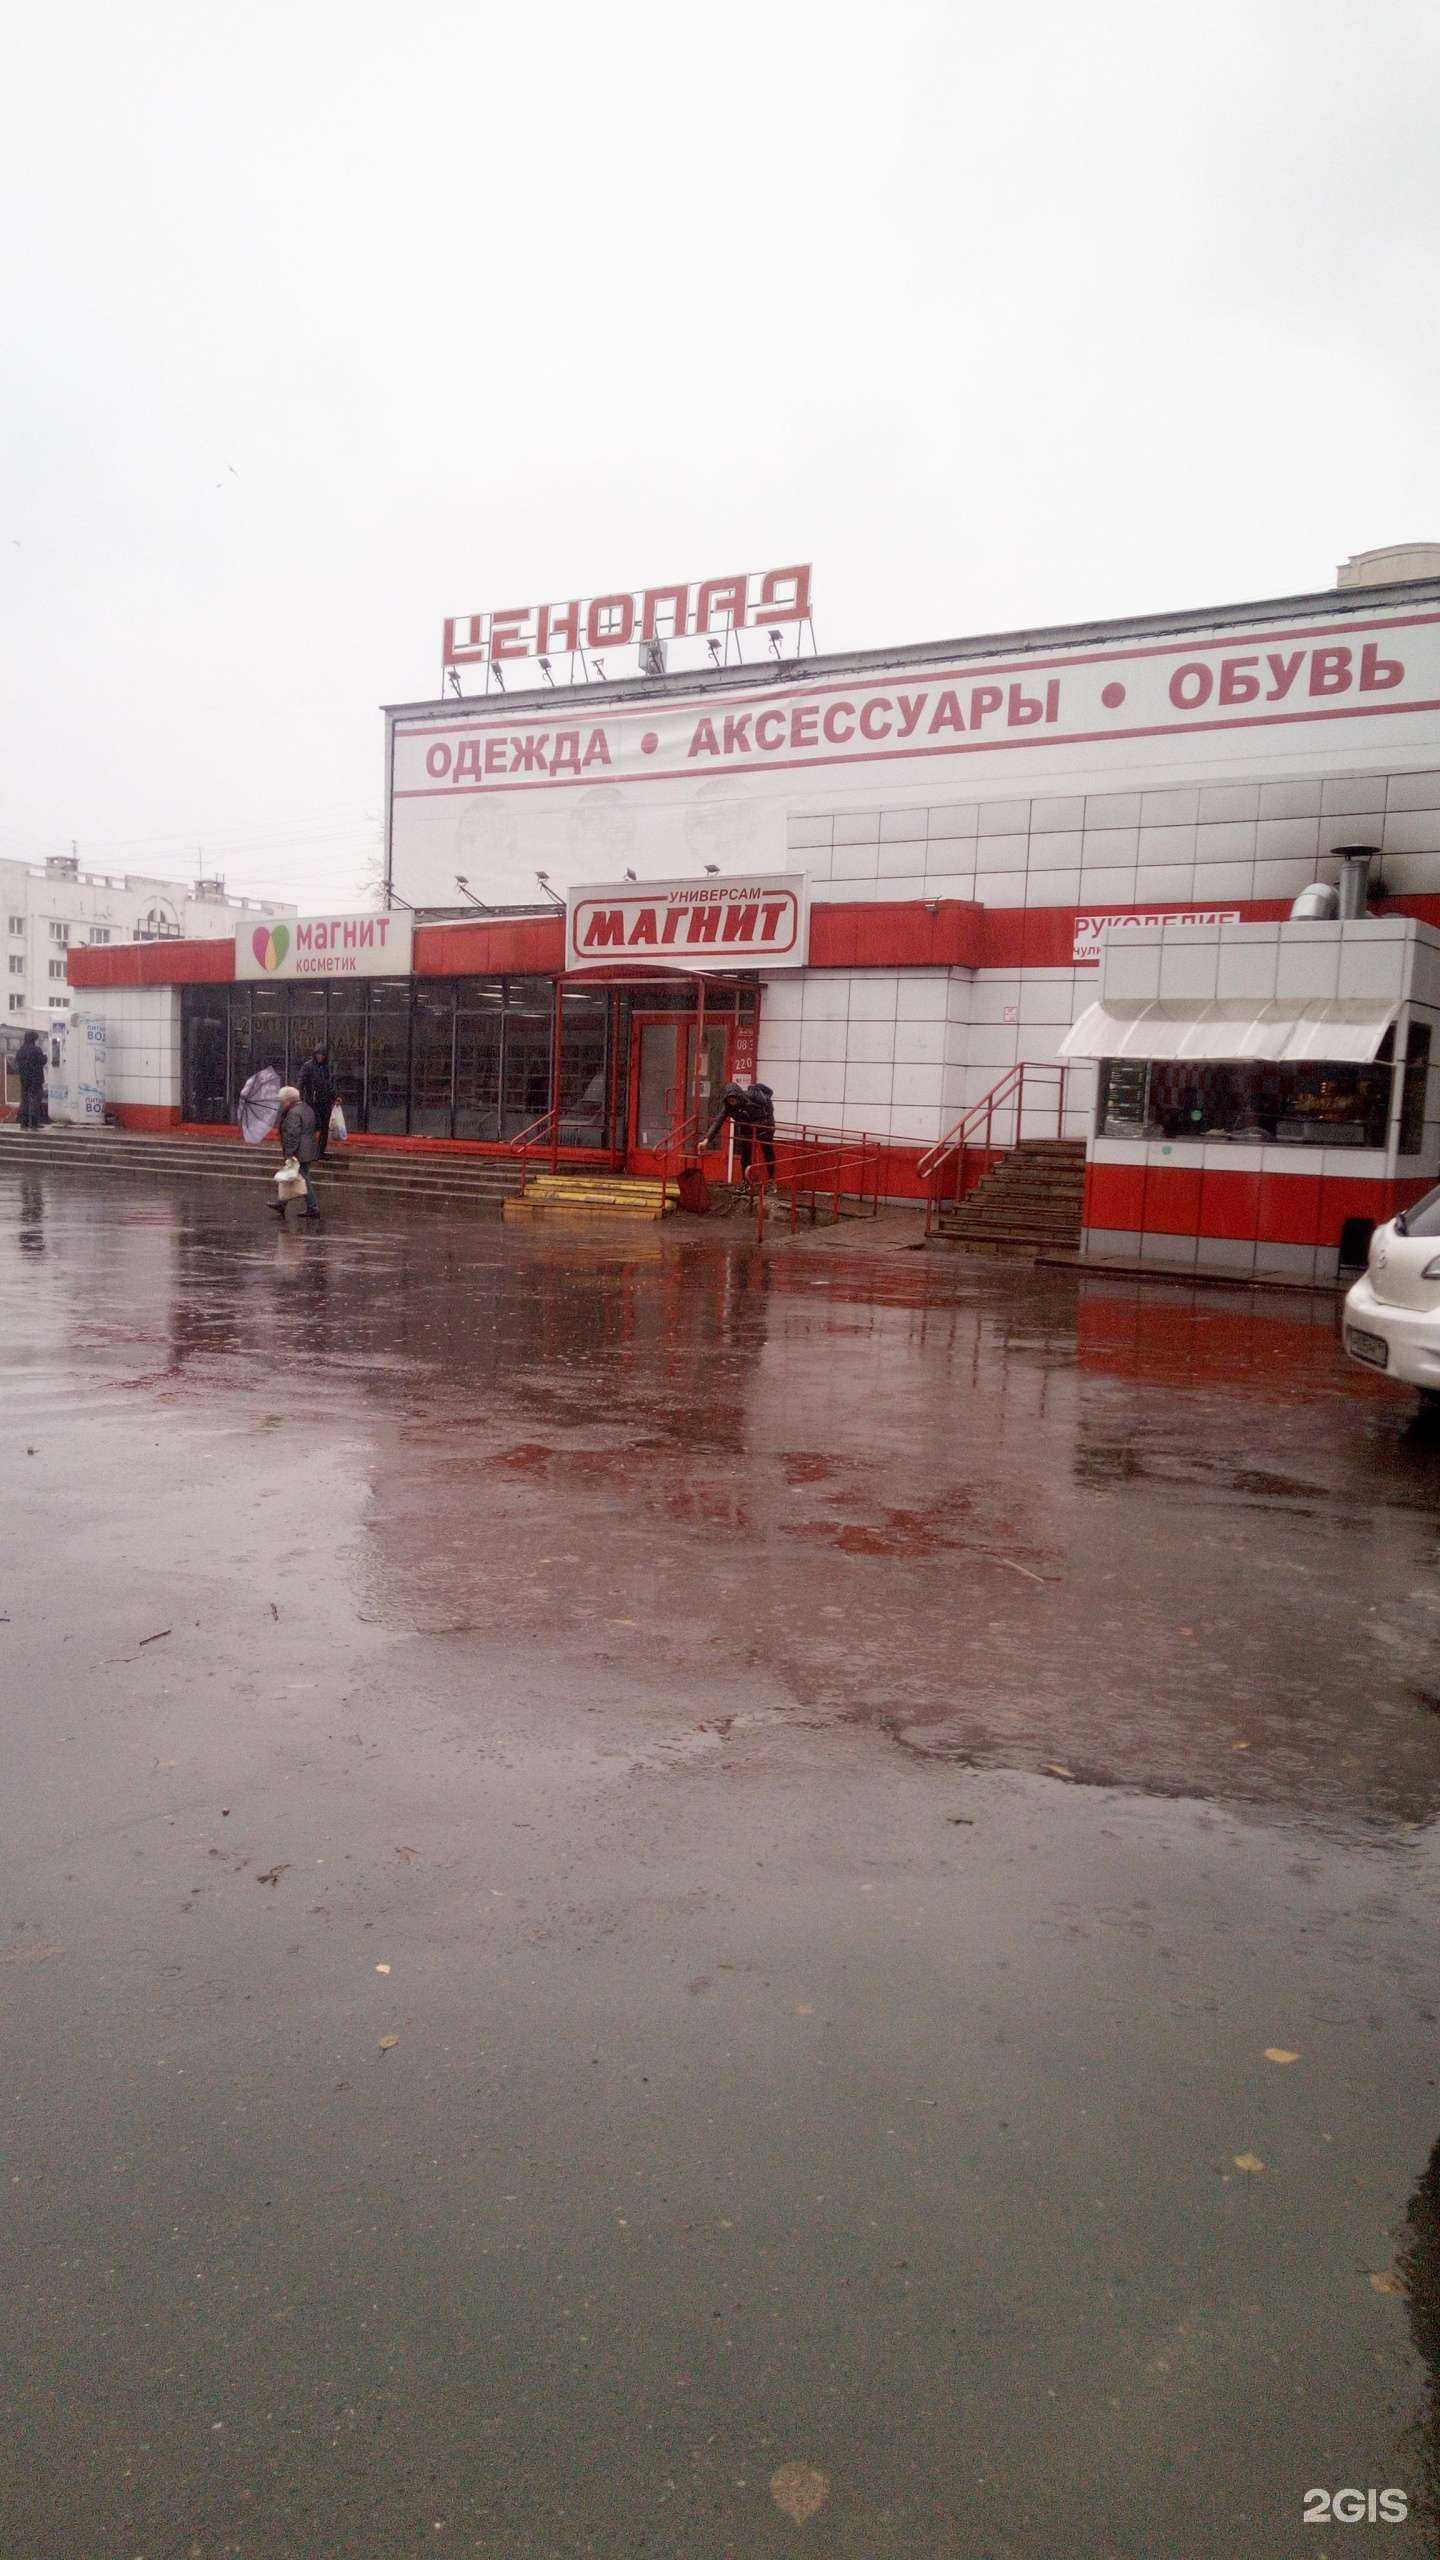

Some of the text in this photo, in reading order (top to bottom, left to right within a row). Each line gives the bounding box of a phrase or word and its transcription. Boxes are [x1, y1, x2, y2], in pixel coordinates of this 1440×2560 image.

[443, 563, 812, 666] ЦЕНОПАД
[426, 642, 1406, 783] ОДЕЖДА АКСЕССУАРЫ ОБУВЬ
[583, 901, 787, 947] МАГНИТ
[668, 887, 761, 903] УНИВЕРСАМ
